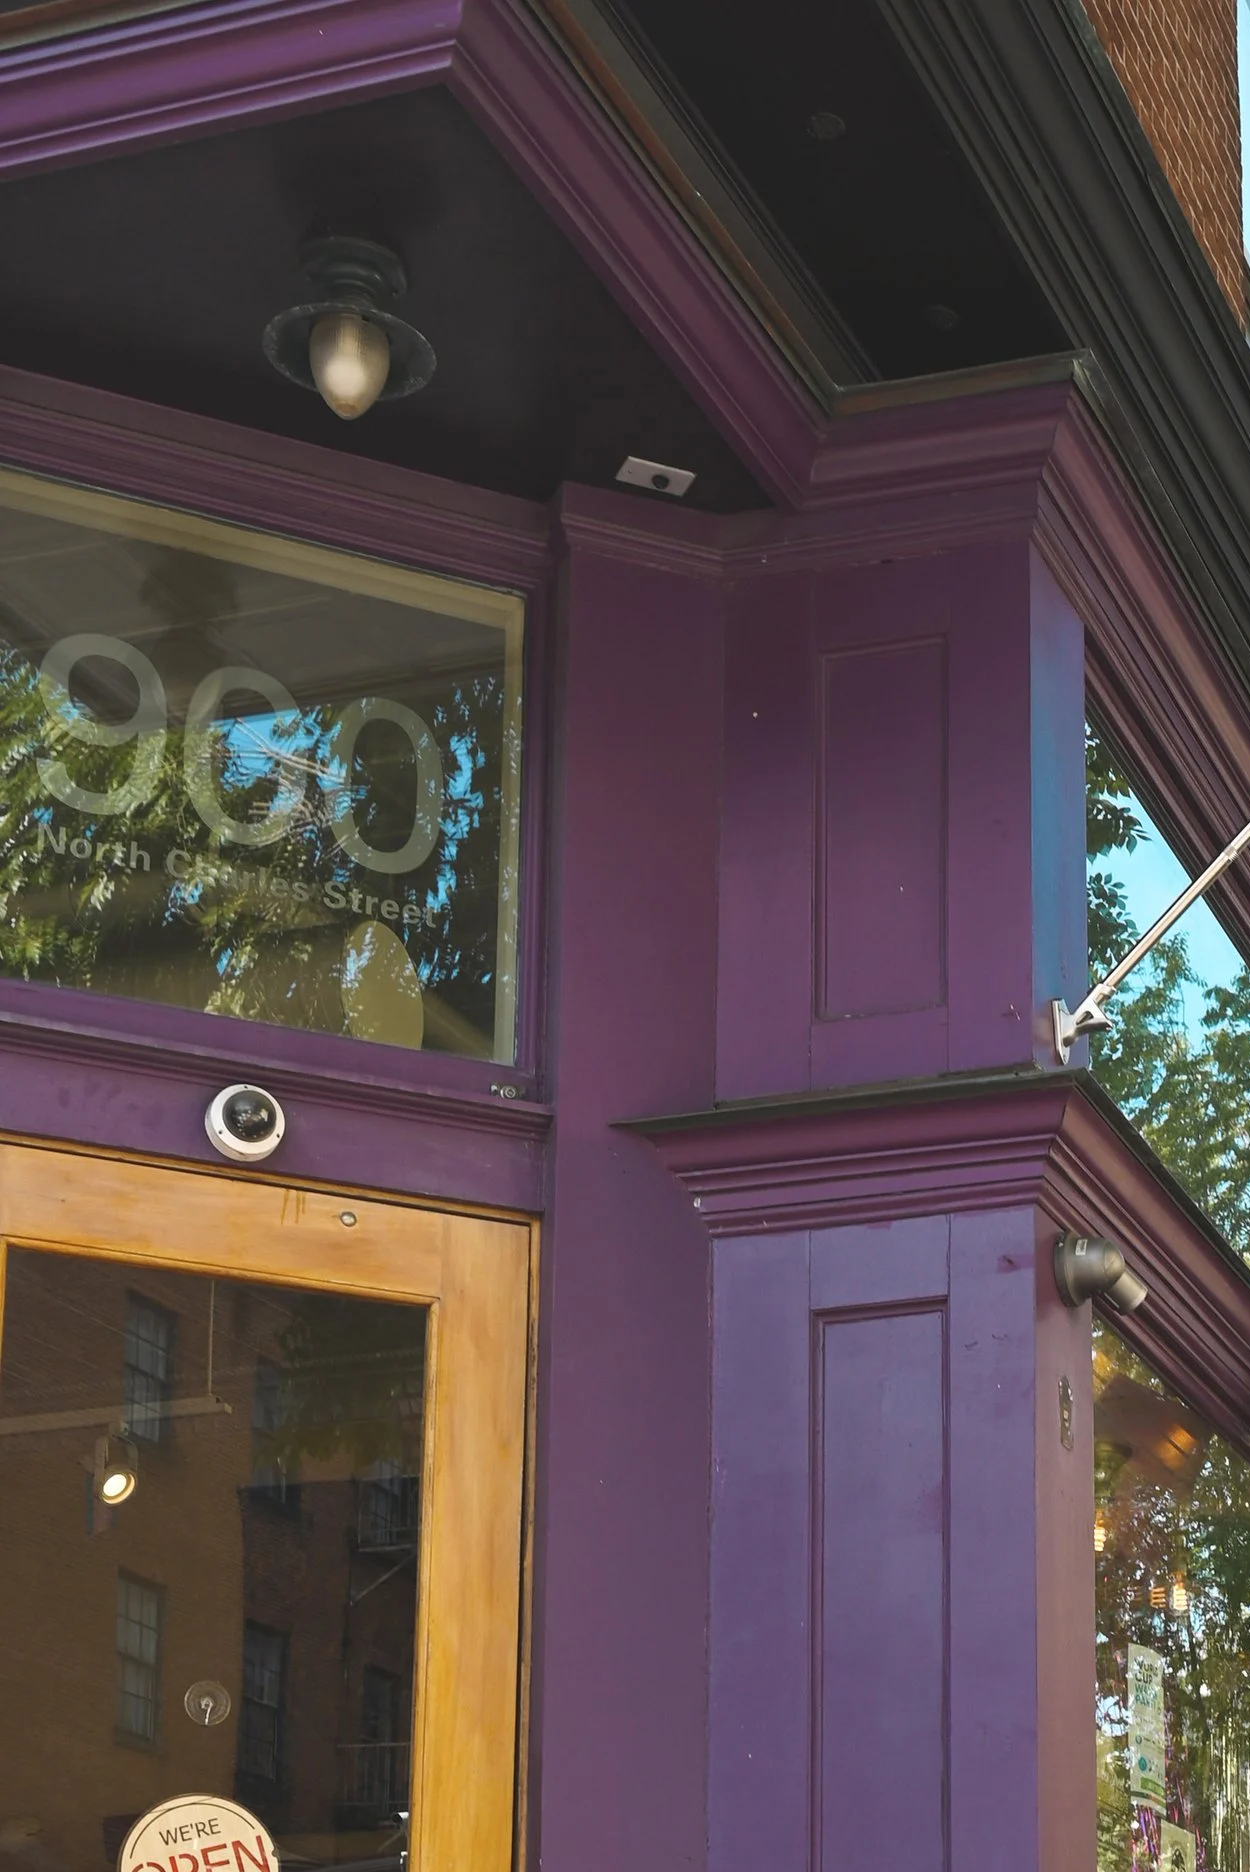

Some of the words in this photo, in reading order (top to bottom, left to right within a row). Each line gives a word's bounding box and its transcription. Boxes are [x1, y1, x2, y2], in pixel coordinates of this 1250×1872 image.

[37, 633, 442, 874] 900
[36, 821, 151, 871] North
[167, 849, 309, 902] Charles
[323, 881, 437, 928] Street
[159, 1818, 221, 1846] WE'RE
